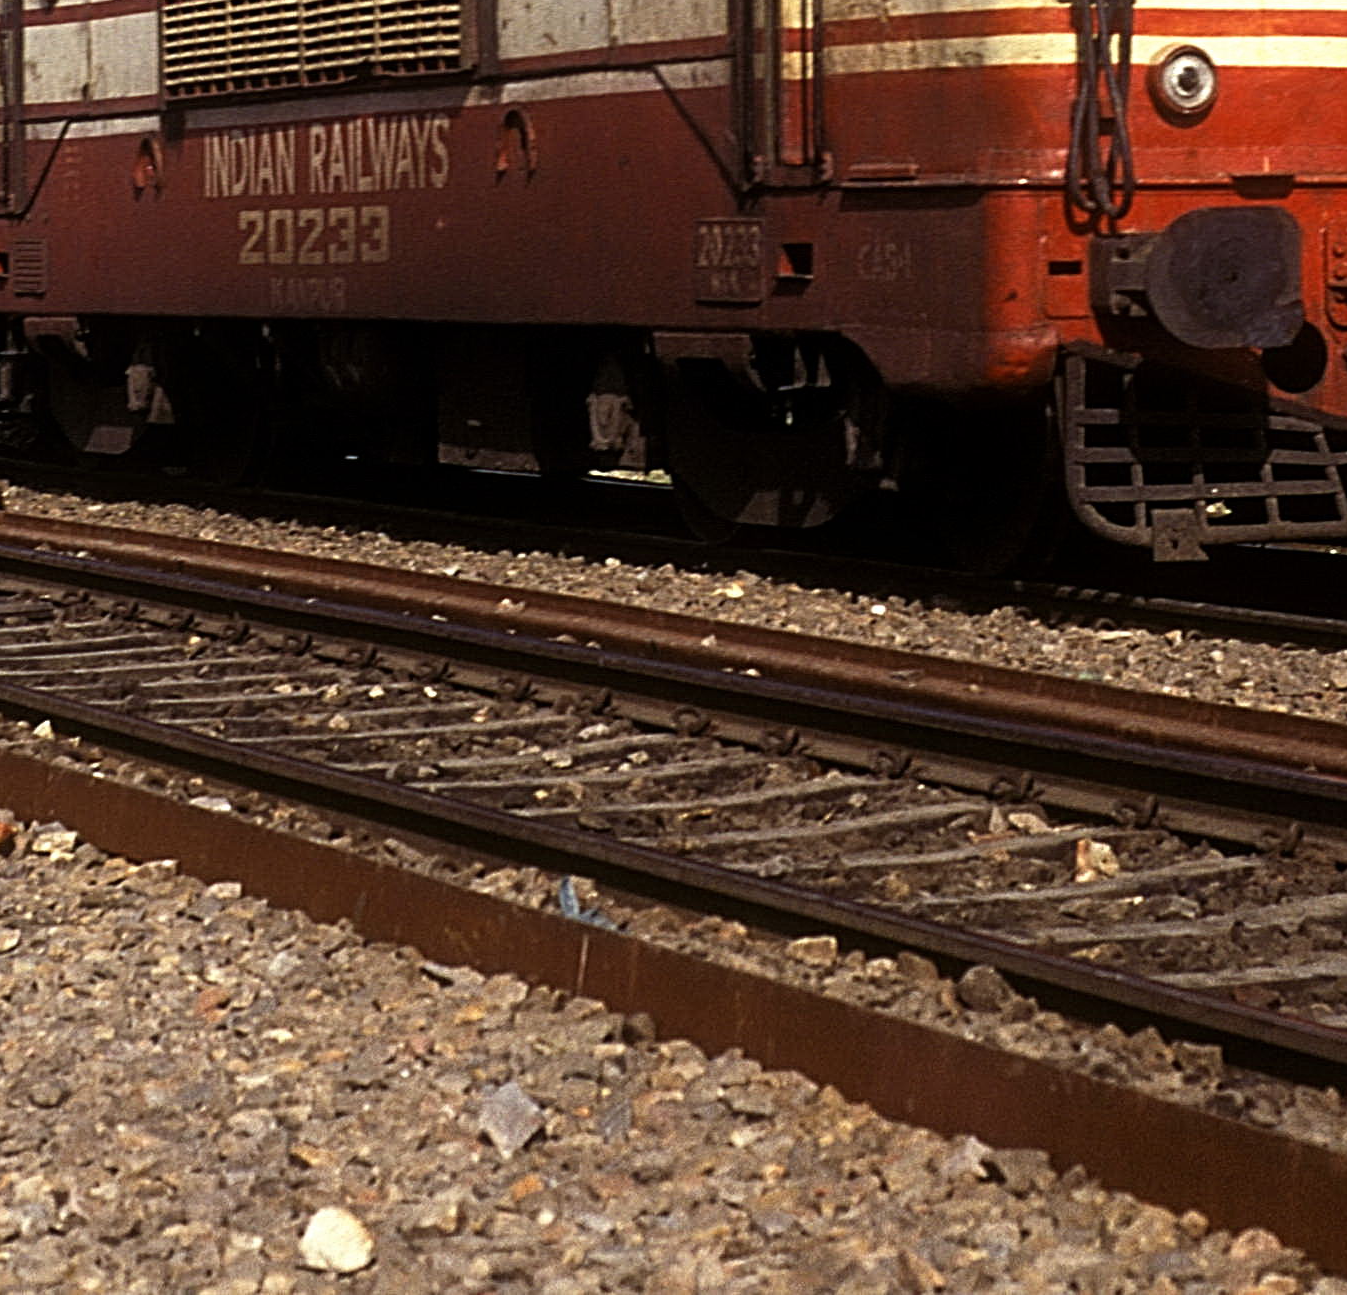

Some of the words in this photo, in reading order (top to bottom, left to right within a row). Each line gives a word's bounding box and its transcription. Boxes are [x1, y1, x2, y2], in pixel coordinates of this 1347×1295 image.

[204, 129, 295, 197] INDIAN
[309, 114, 450, 193] RAILWAYS
[237, 206, 391, 265] 20233
